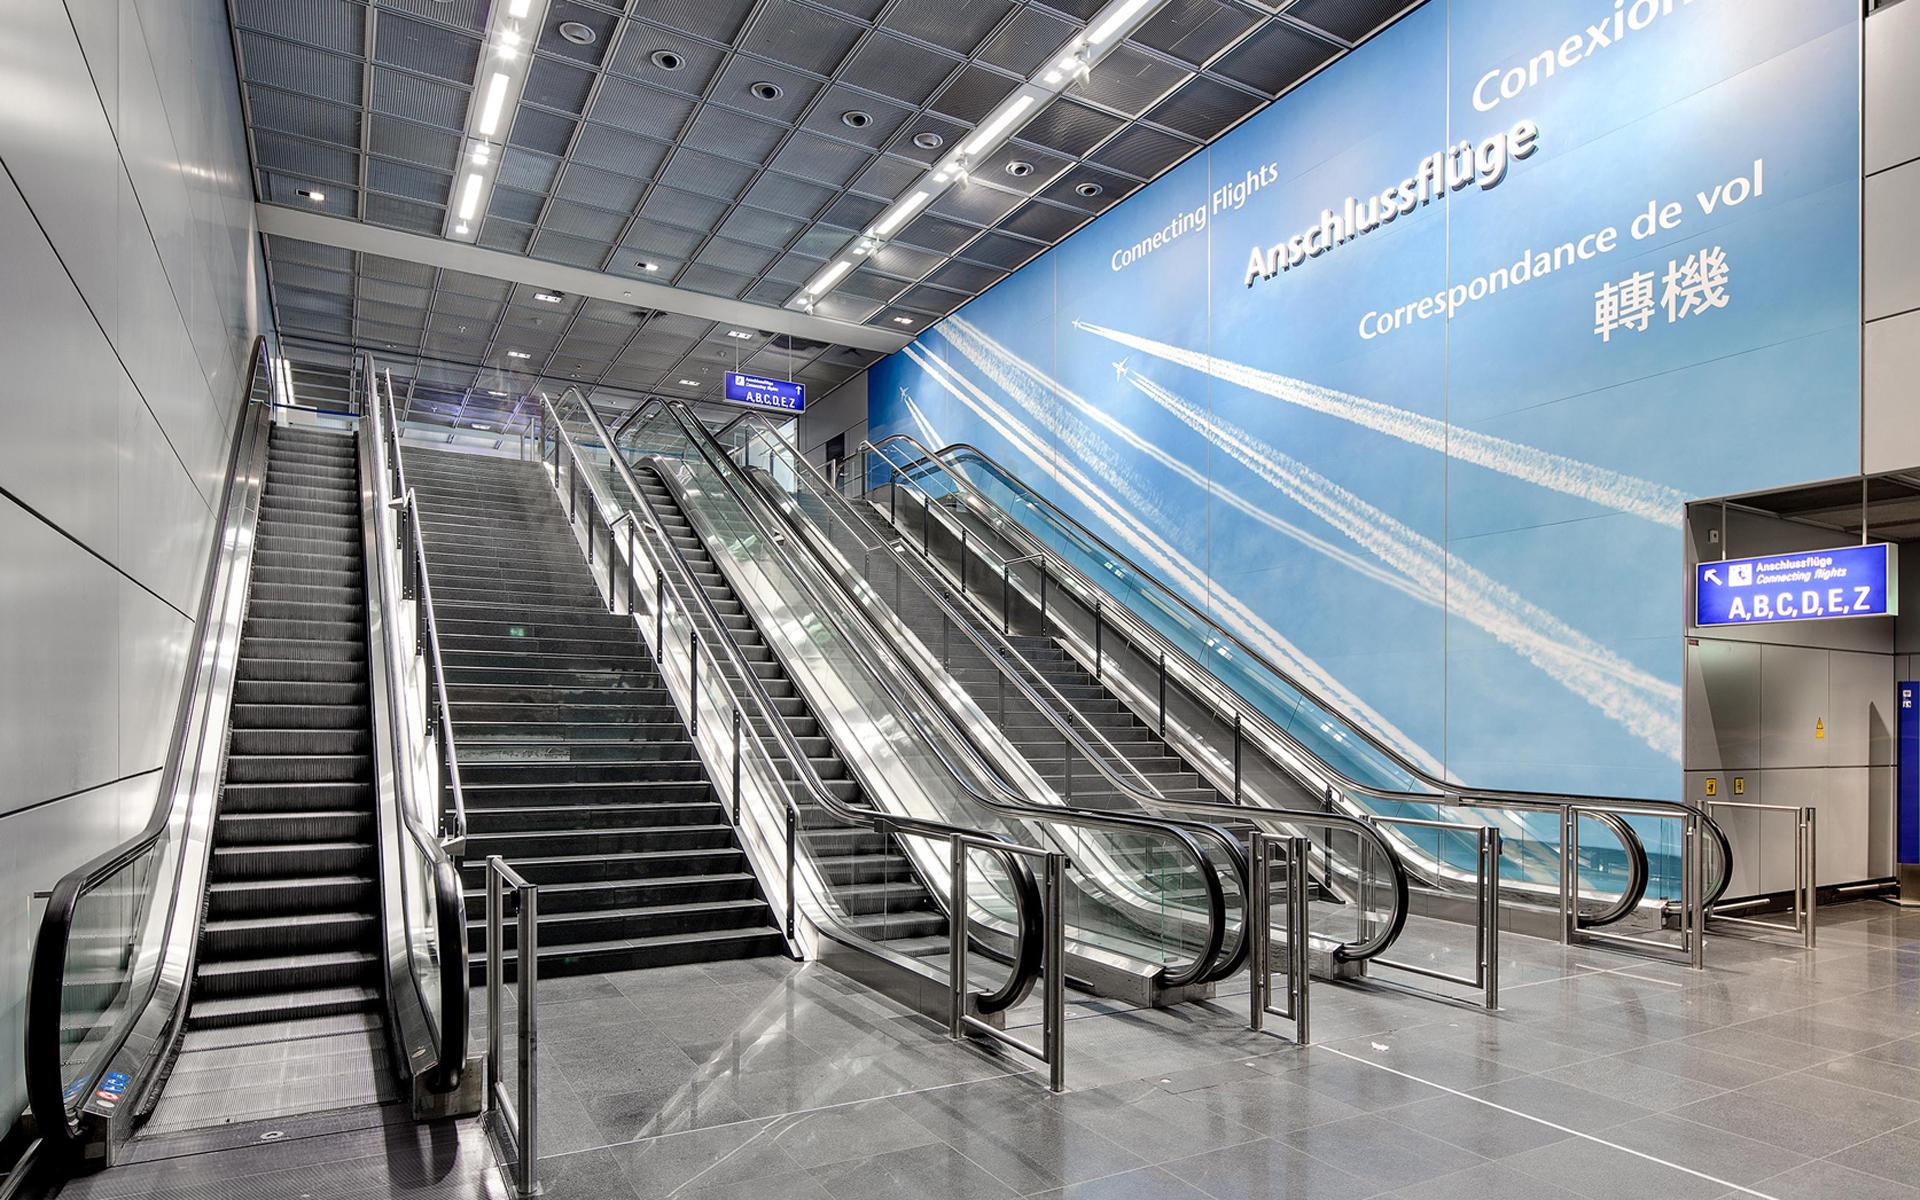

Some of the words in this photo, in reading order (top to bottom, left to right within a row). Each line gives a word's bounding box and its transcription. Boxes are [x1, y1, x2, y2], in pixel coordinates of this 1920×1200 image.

[1111, 204, 1207, 272] Connecting
[1212, 162, 1279, 216] Flights
[1244, 119, 1539, 288] Anschlussflüge
[1358, 226, 1617, 340] Correspondance
[1630, 200, 1682, 240] de
[1696, 158, 1763, 215] vol
[1592, 245, 1731, 343] 轉機
[1756, 557, 1833, 572] Anschlussflüge
[1756, 571, 1812, 585] Connecting
[1814, 567, 1848, 581] flights
